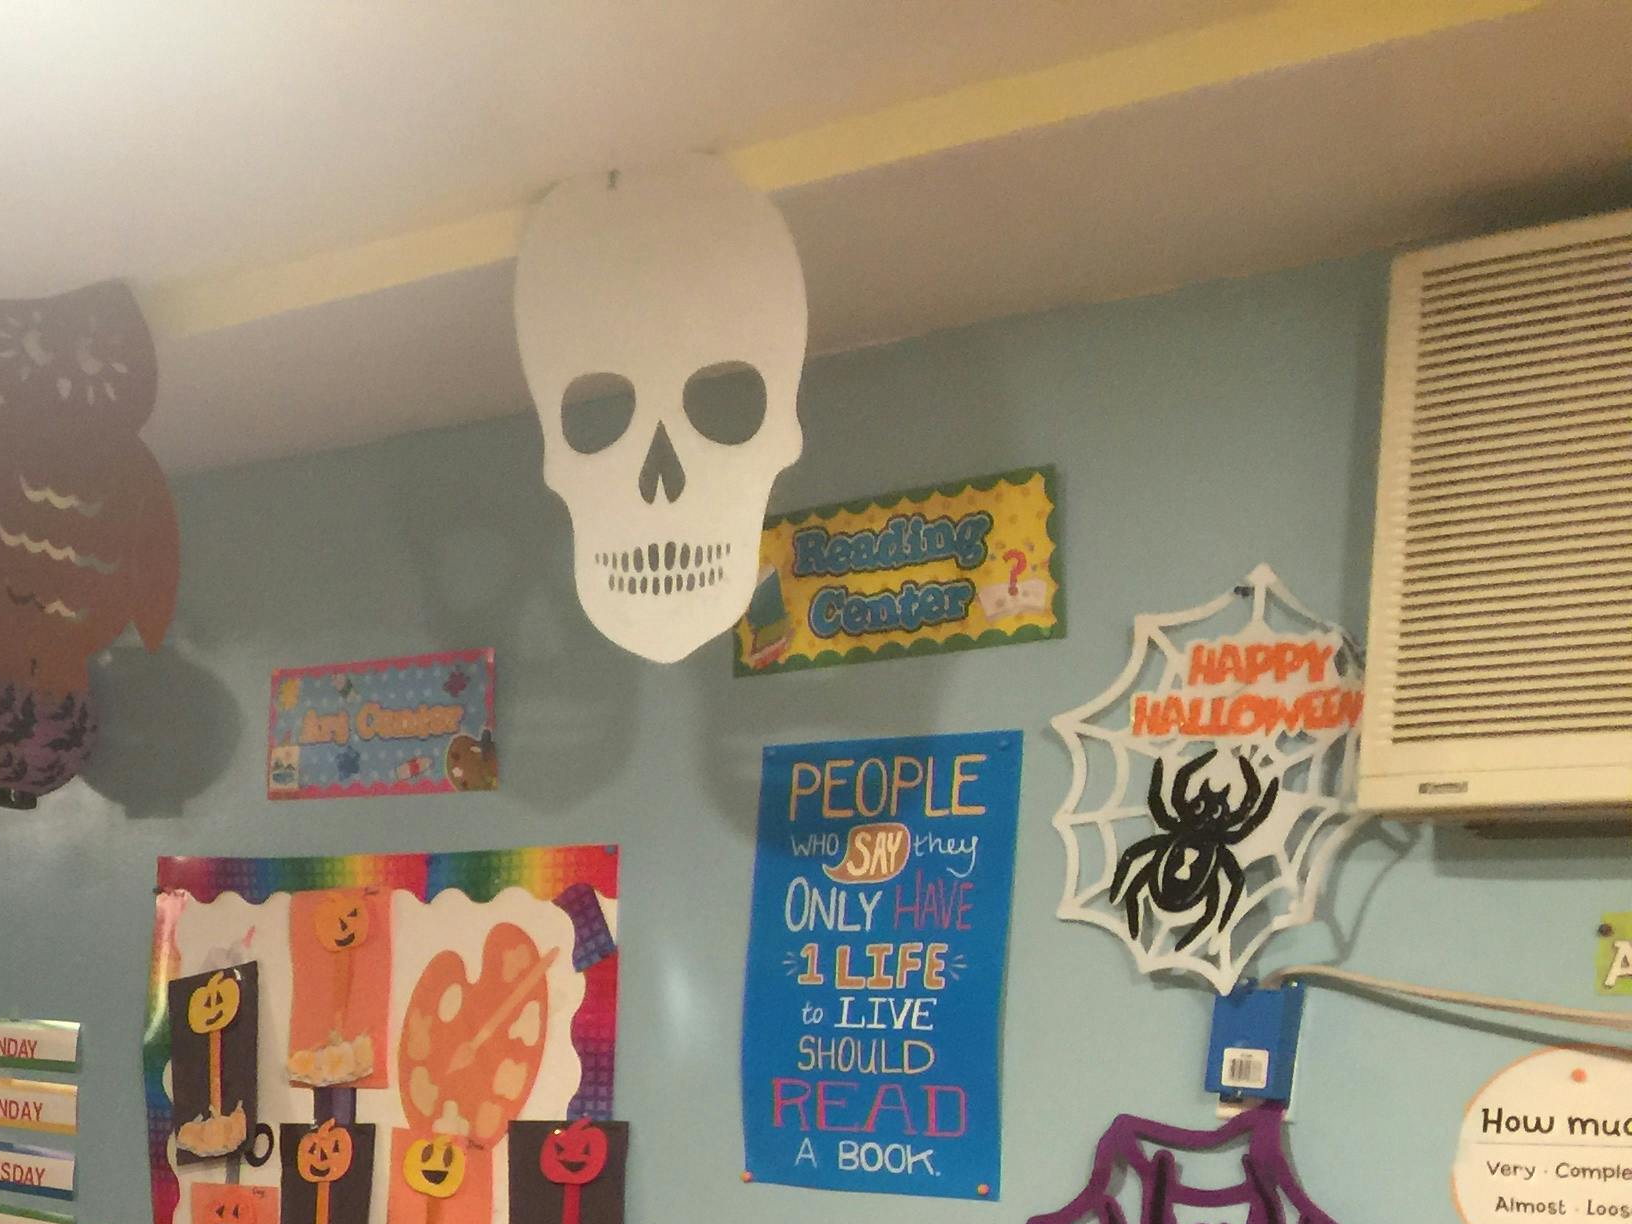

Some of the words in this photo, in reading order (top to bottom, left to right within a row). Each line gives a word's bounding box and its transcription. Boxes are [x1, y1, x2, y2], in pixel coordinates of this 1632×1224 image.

[793, 512, 992, 577] Reading
[809, 579, 976, 638] Center
[1187, 639, 1334, 687] HAPPY
[1132, 686, 1365, 737] HALLOWEEN
[789, 753, 988, 822] PEOPLE
[791, 832, 839, 857] WHO
[846, 829, 901, 876] SAY
[914, 833, 978, 878] they
[785, 876, 882, 933] ONLY
[894, 869, 974, 931] HAVE
[798, 943, 824, 985] 1
[835, 943, 950, 990] LIFE
[801, 1002, 824, 1025] to
[834, 996, 937, 1031] LIVE
[797, 1035, 935, 1075] SHOULD
[772, 1077, 967, 1138] READ
[1481, 1107, 1555, 1135] How
[795, 1137, 818, 1168] A
[838, 1140, 942, 1177] BOOK.
[1486, 1160, 1536, 1181] Very
[1495, 1196, 1567, 1216] Almost
